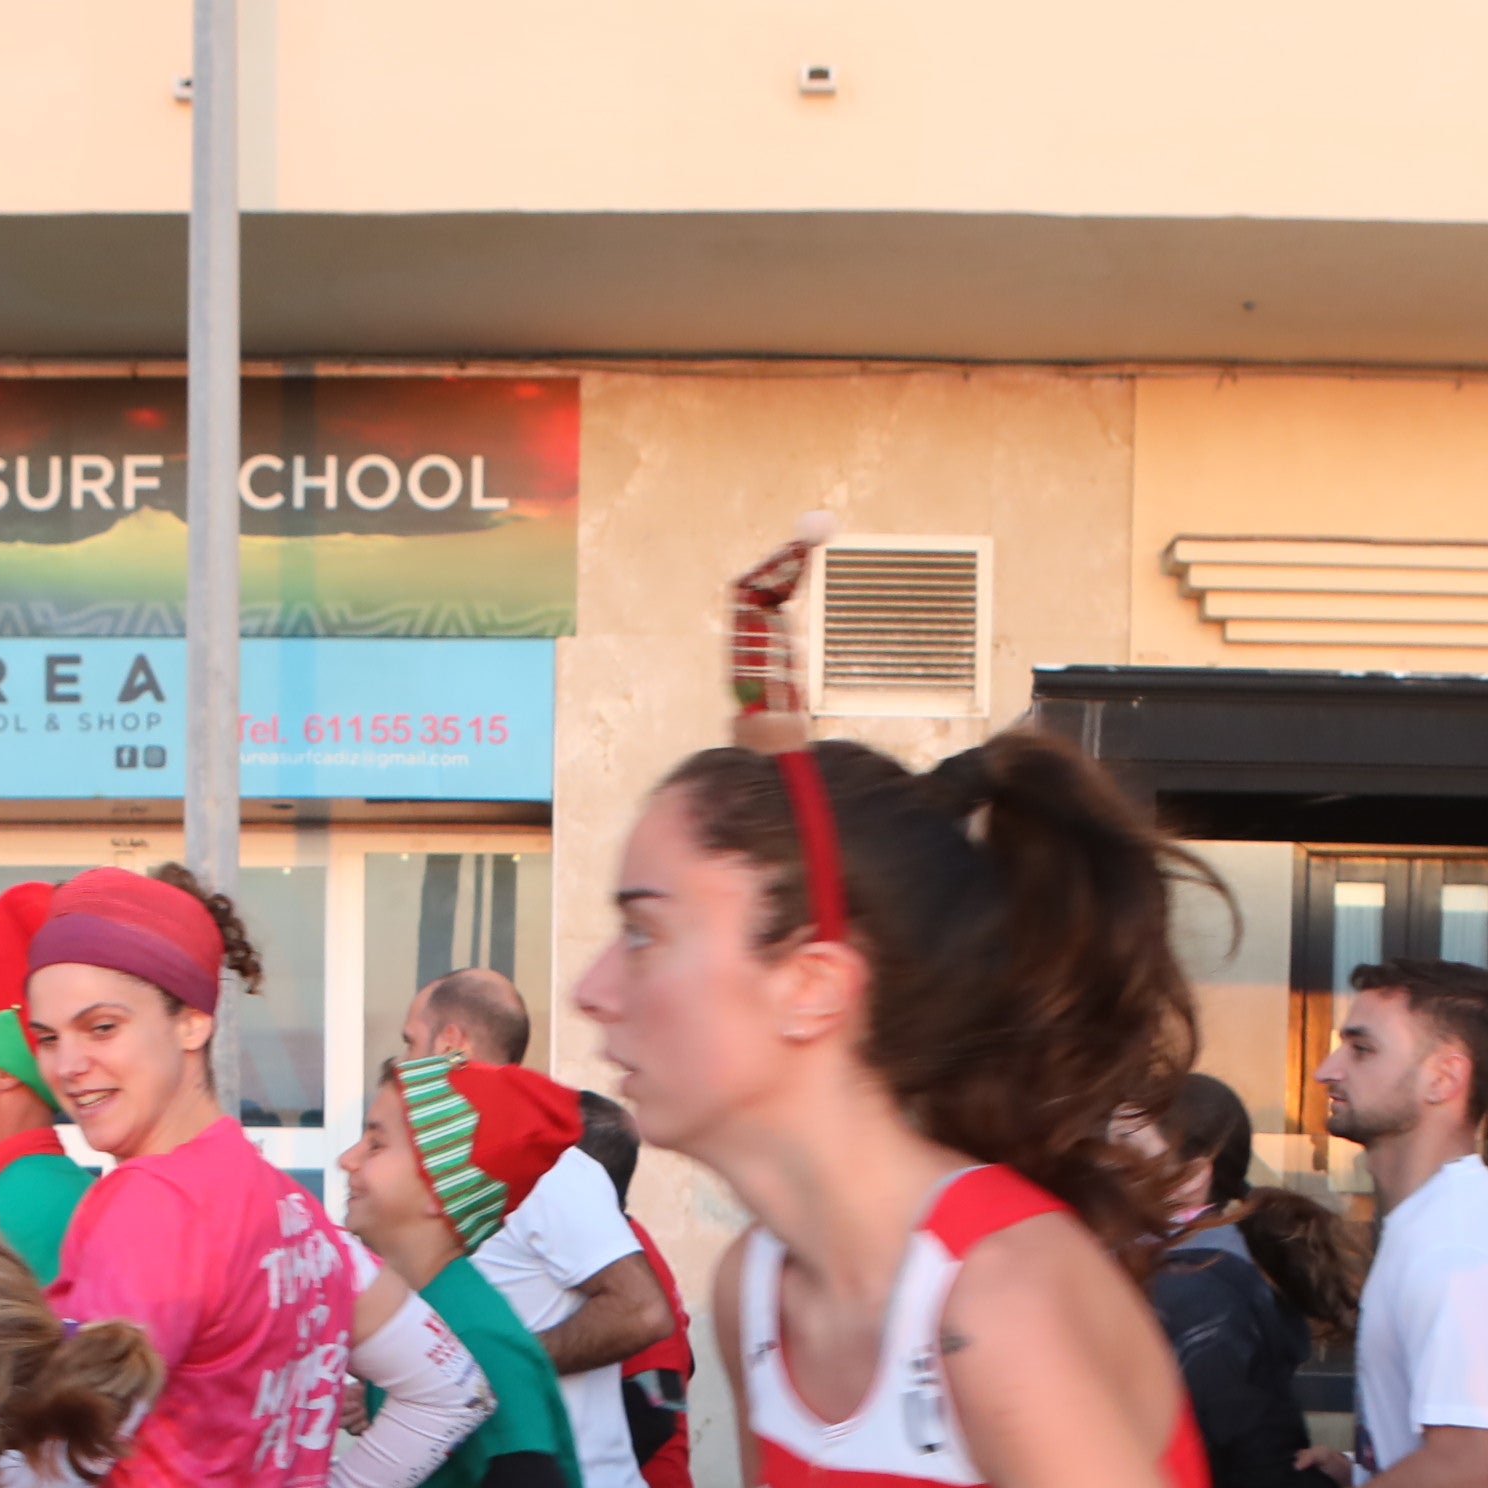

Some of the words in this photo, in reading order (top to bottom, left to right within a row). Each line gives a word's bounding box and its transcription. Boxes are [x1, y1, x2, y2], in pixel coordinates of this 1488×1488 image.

[238, 454, 509, 511] CHOOL
[45, 713, 61, 732] &
[78, 712, 163, 733] SHOP
[239, 749, 470, 767] ureasurfcadiz@gmail.com
